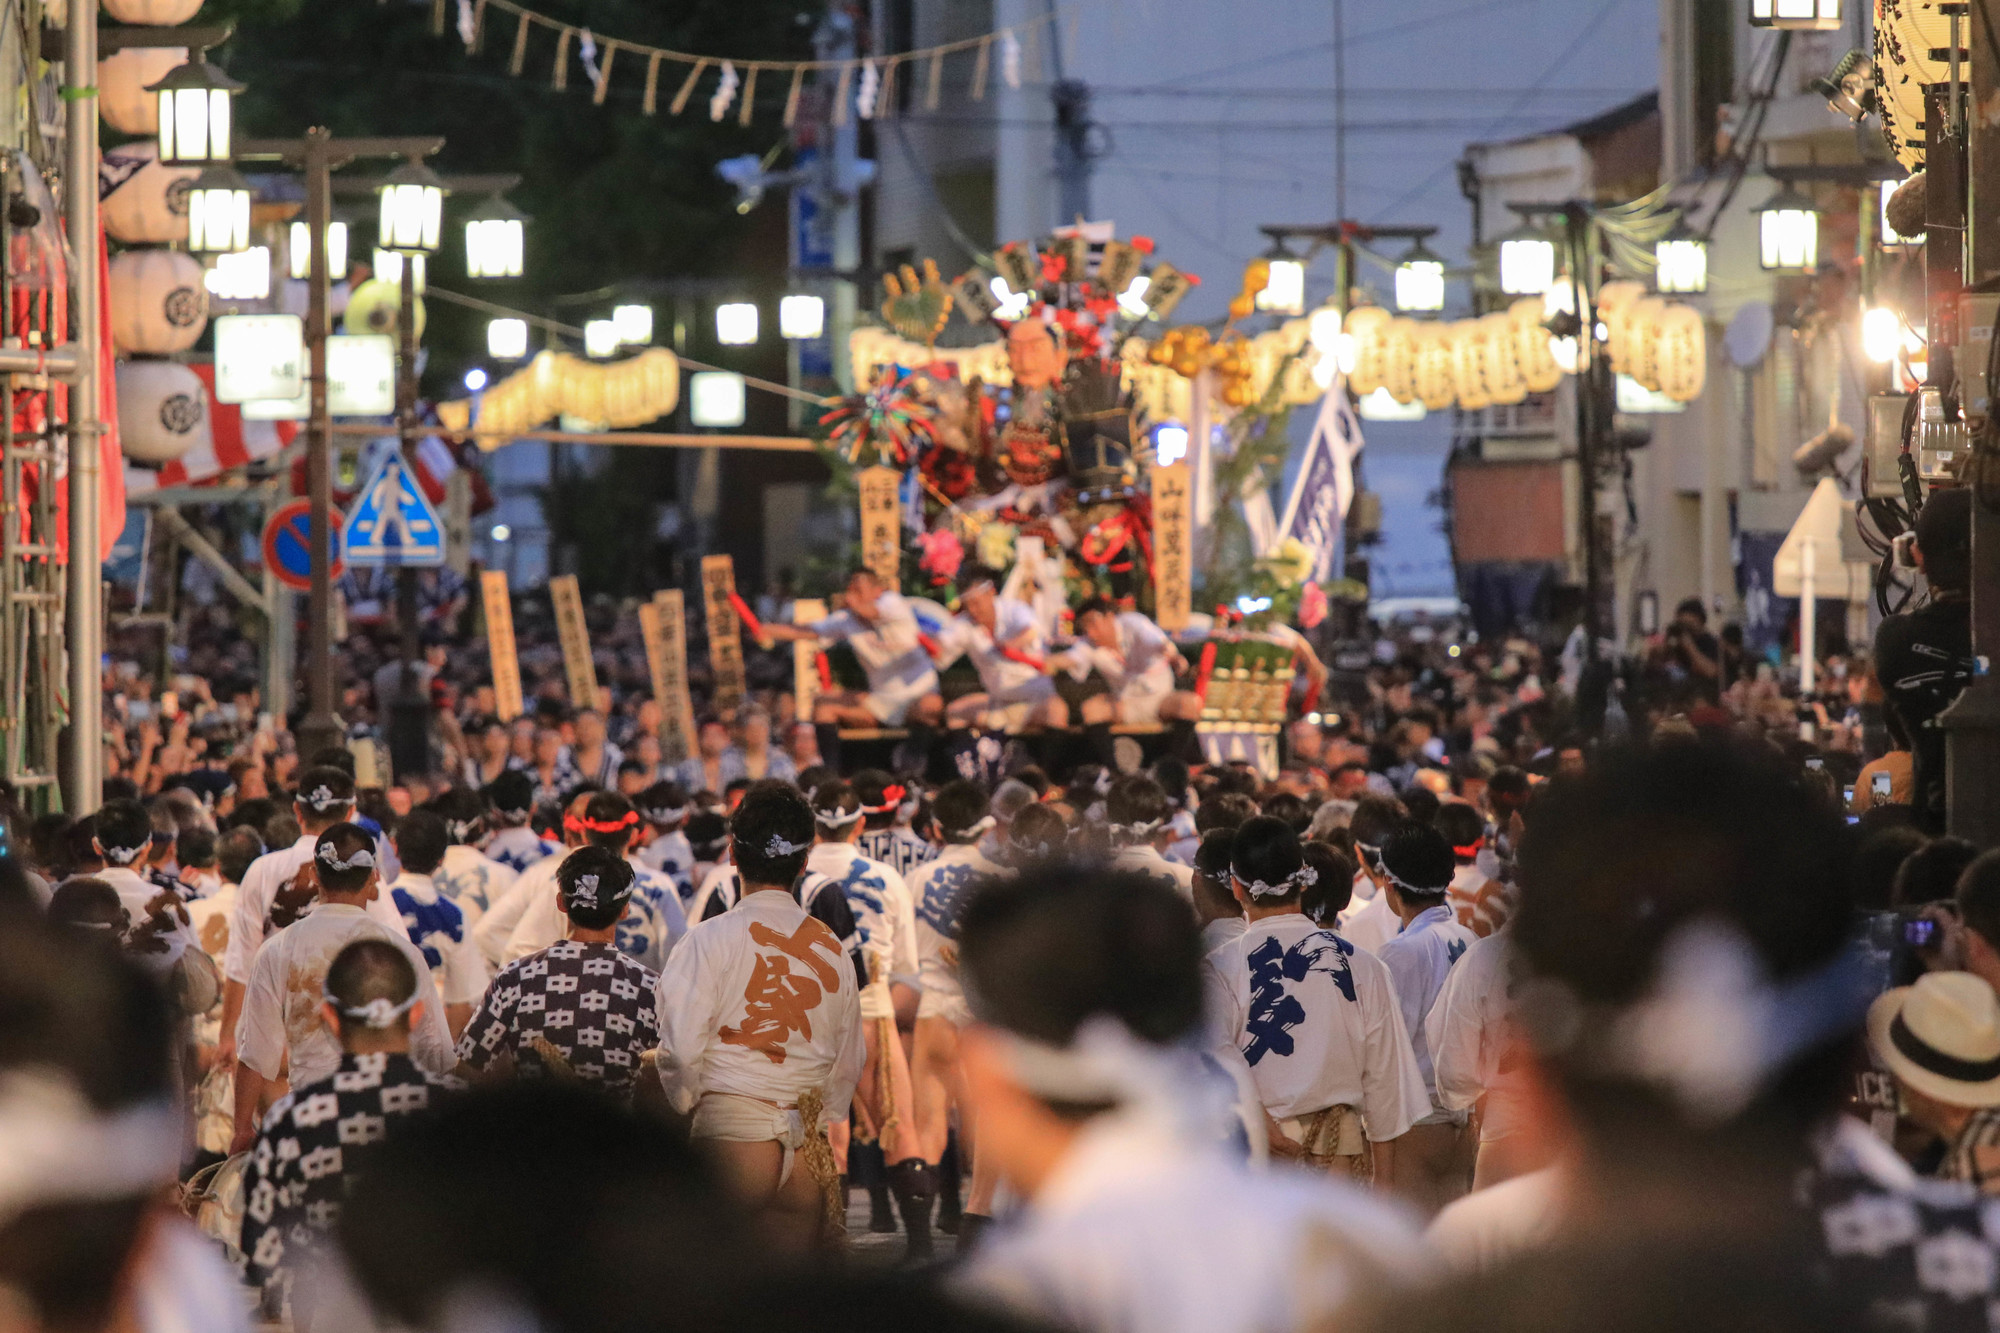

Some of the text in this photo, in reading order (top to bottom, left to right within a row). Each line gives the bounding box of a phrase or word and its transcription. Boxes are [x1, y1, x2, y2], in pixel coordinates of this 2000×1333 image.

[583, 957, 615, 976] 中
[546, 973, 578, 994] 中
[610, 978, 639, 1000] 中
[517, 992, 546, 1014] 中
[579, 990, 609, 1011] 中
[544, 1009, 574, 1029] 中
[606, 1014, 636, 1036] 中
[577, 1026, 605, 1047] 中
[604, 1048, 631, 1067] 中
[380, 1083, 428, 1115] 中
[293, 1093, 339, 1128] 中
[338, 1112, 385, 1145] 中
[300, 1146, 342, 1180] 中
